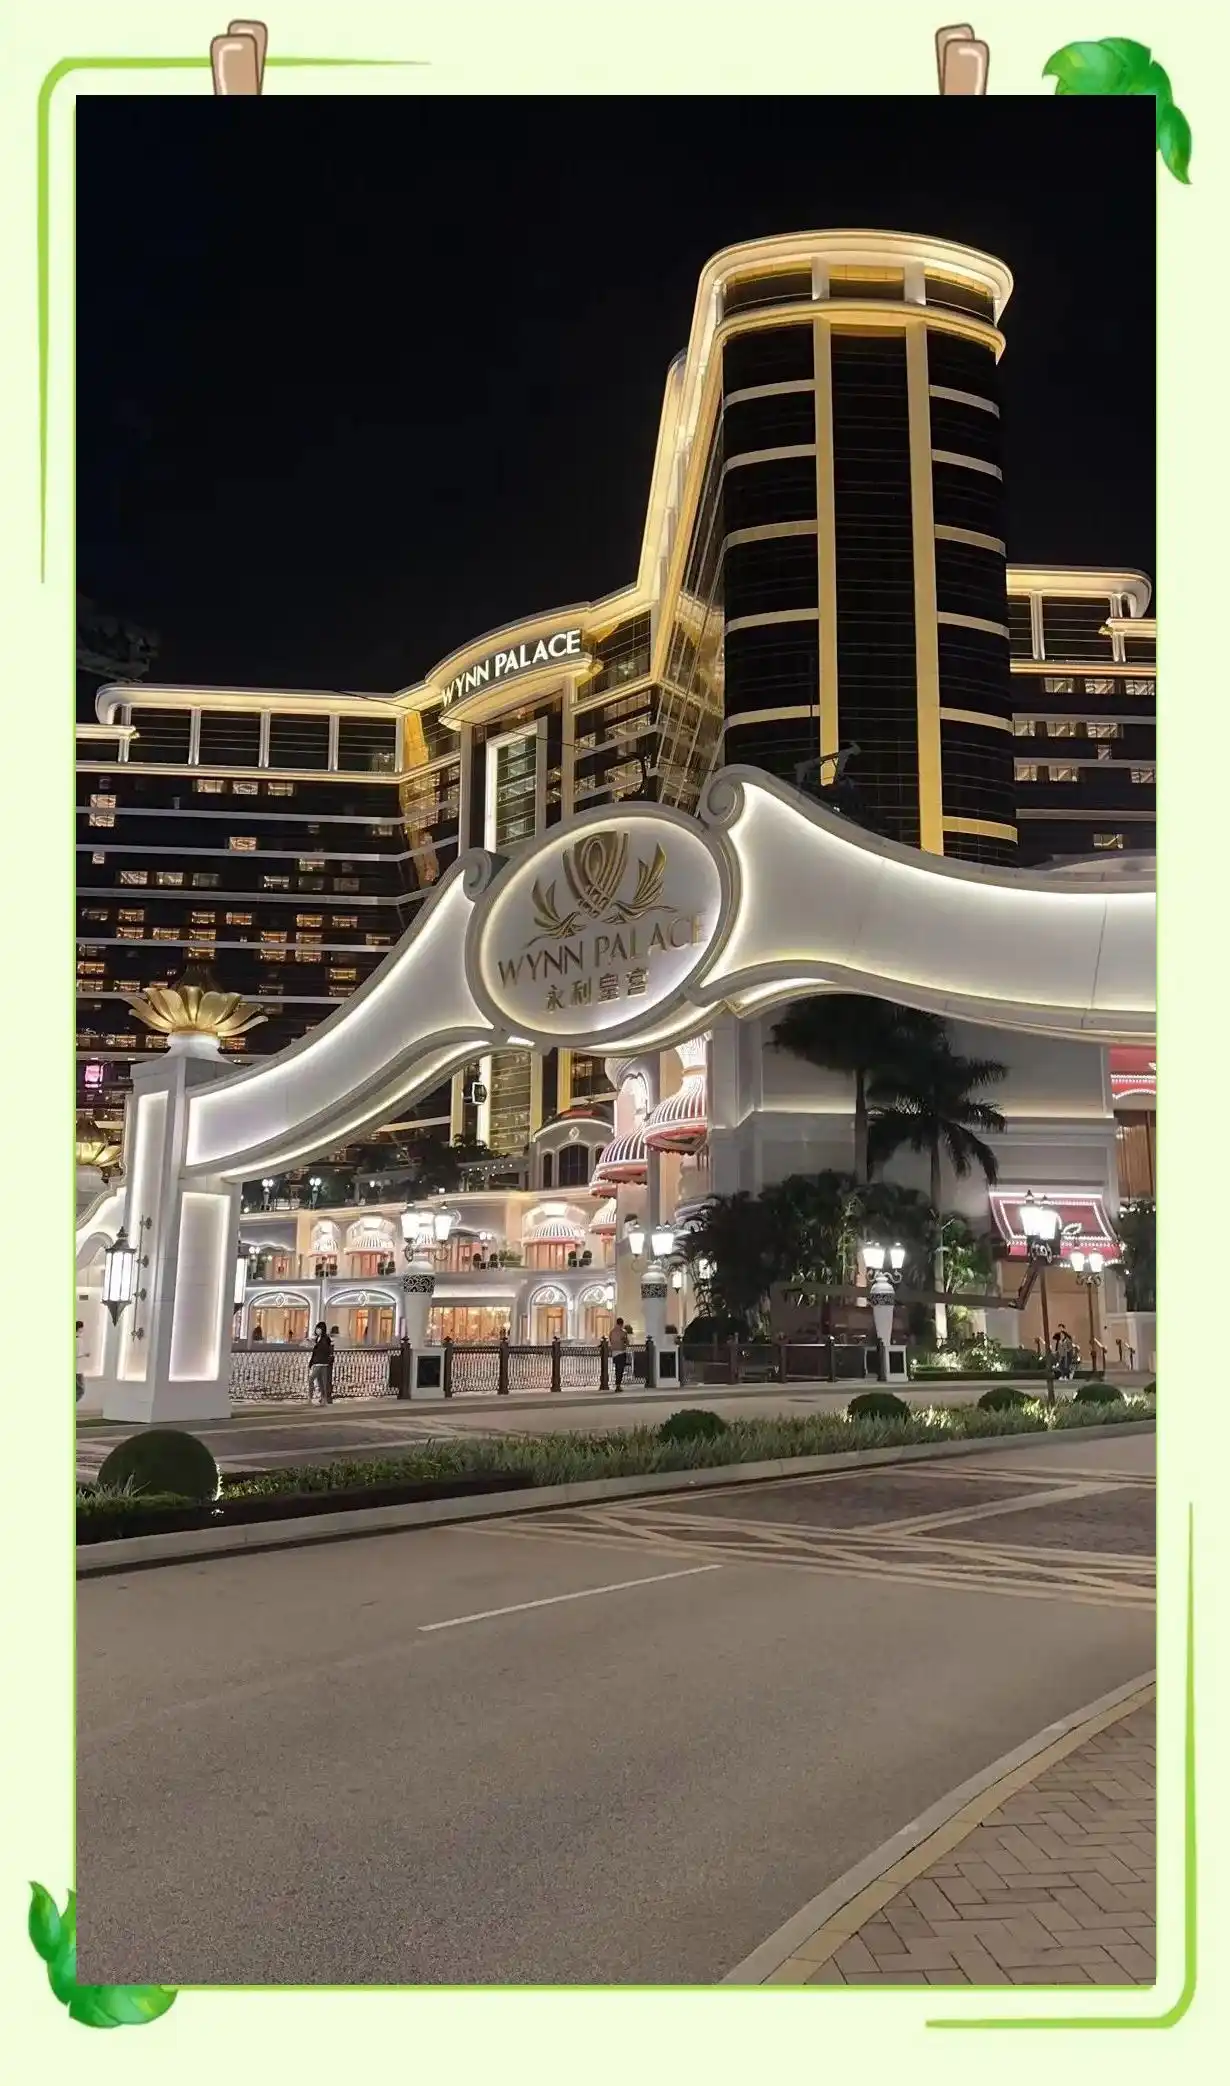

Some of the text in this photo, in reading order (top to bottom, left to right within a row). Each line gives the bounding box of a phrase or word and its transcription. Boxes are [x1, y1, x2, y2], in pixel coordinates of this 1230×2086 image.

[441, 629, 581, 706] WYNN PALACE
[497, 914, 704, 989] WYNN PALACE
